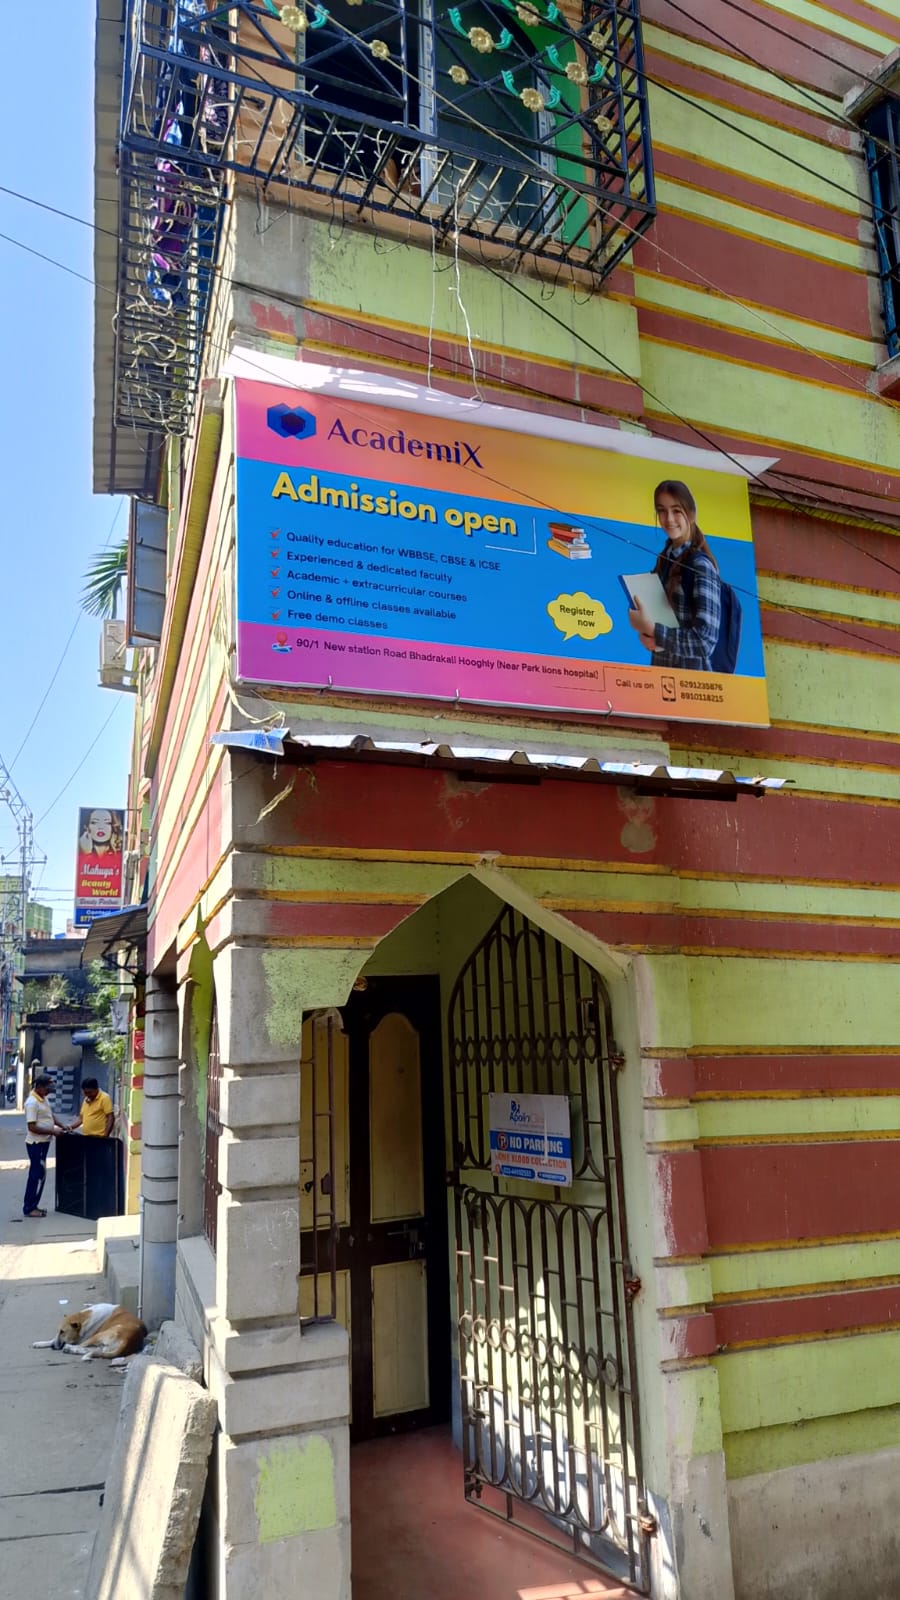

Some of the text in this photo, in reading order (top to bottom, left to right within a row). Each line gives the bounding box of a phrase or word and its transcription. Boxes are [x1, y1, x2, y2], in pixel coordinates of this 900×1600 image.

[327, 418, 484, 469] AcademiX
[271, 472, 518, 537] Admission open
[286, 532, 501, 571] Quality education for WBBSE, CBSE & ICSE
[287, 551, 453, 584] Experienced & dedicated faculty
[287, 570, 340, 585] Academic
[352, 579, 426, 597] extracurricular
[428, 590, 467, 602] courses
[287, 590, 456, 619] Online & offline classes available
[559, 604, 595, 617] Register
[287, 609, 389, 630] Free demo classes
[577, 620, 595, 628] now
[296, 638, 319, 649] 90/1
[323, 641, 346, 652] New
[348, 644, 381, 656] station
[383, 648, 407, 659] Road
[409, 651, 457, 664] Bhadrakali
[458, 656, 495, 670] Hooghly
[521, 663, 540, 673] Park
[541, 666, 562, 676] lions
[615, 679, 655, 690] Call us on
[81, 879, 112, 889] Beauty
[91, 888, 119, 896] World
[509, 1136, 522, 1149] NO
[531, 1156, 567, 1169] COLCTION
